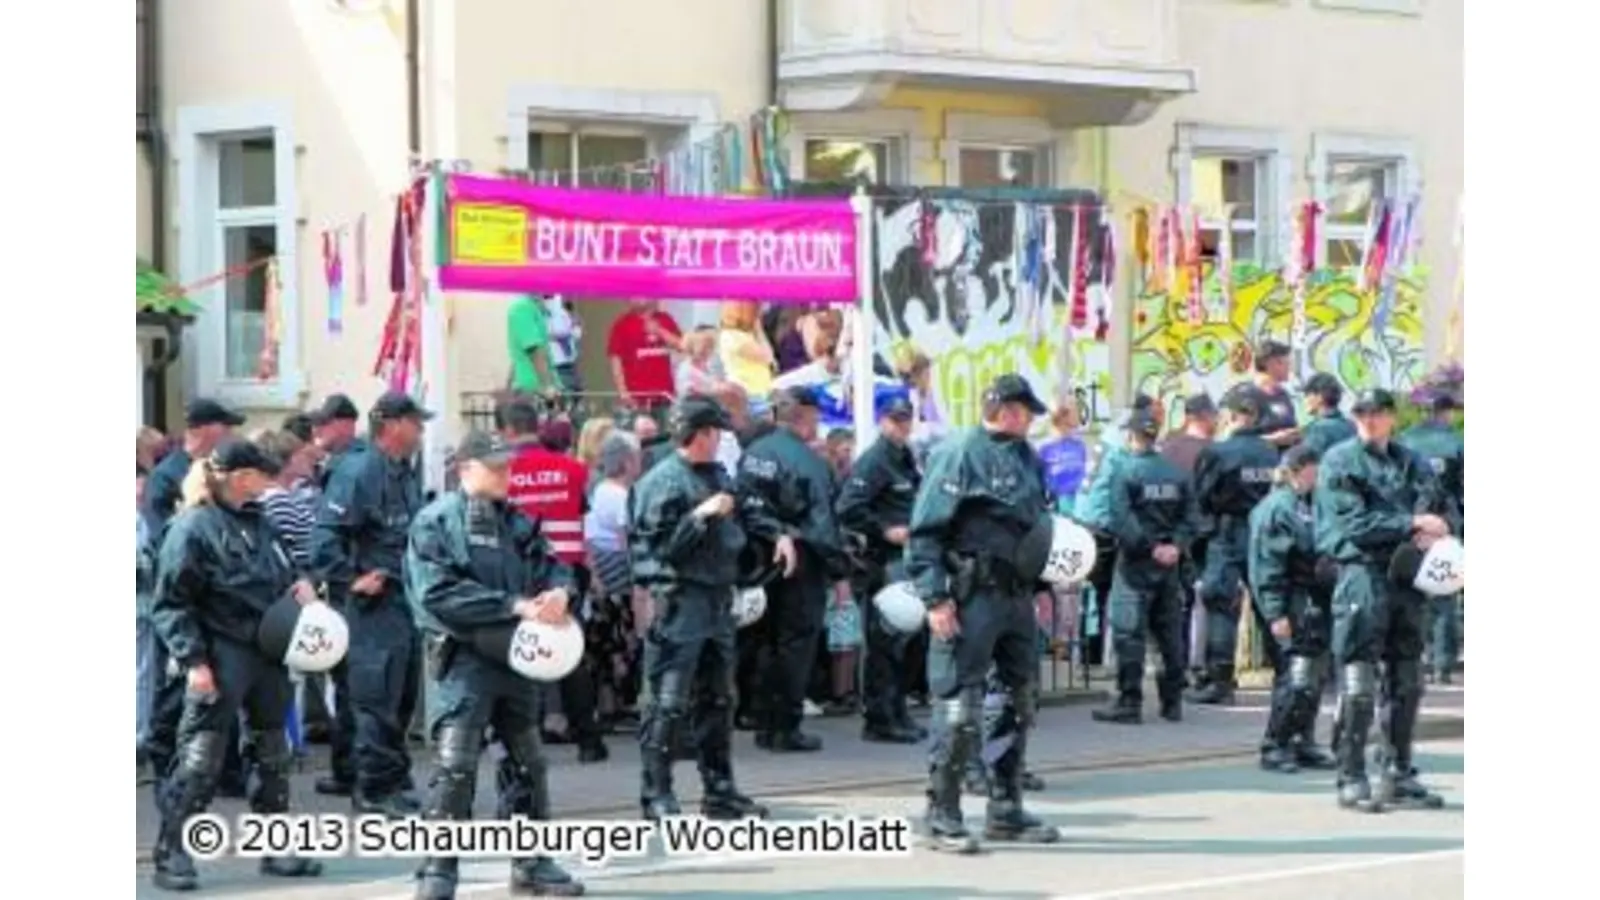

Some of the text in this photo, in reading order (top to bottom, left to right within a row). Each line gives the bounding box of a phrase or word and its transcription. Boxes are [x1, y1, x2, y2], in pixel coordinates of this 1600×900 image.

[536, 216, 852, 275] BUNT STATT BRAUN.
